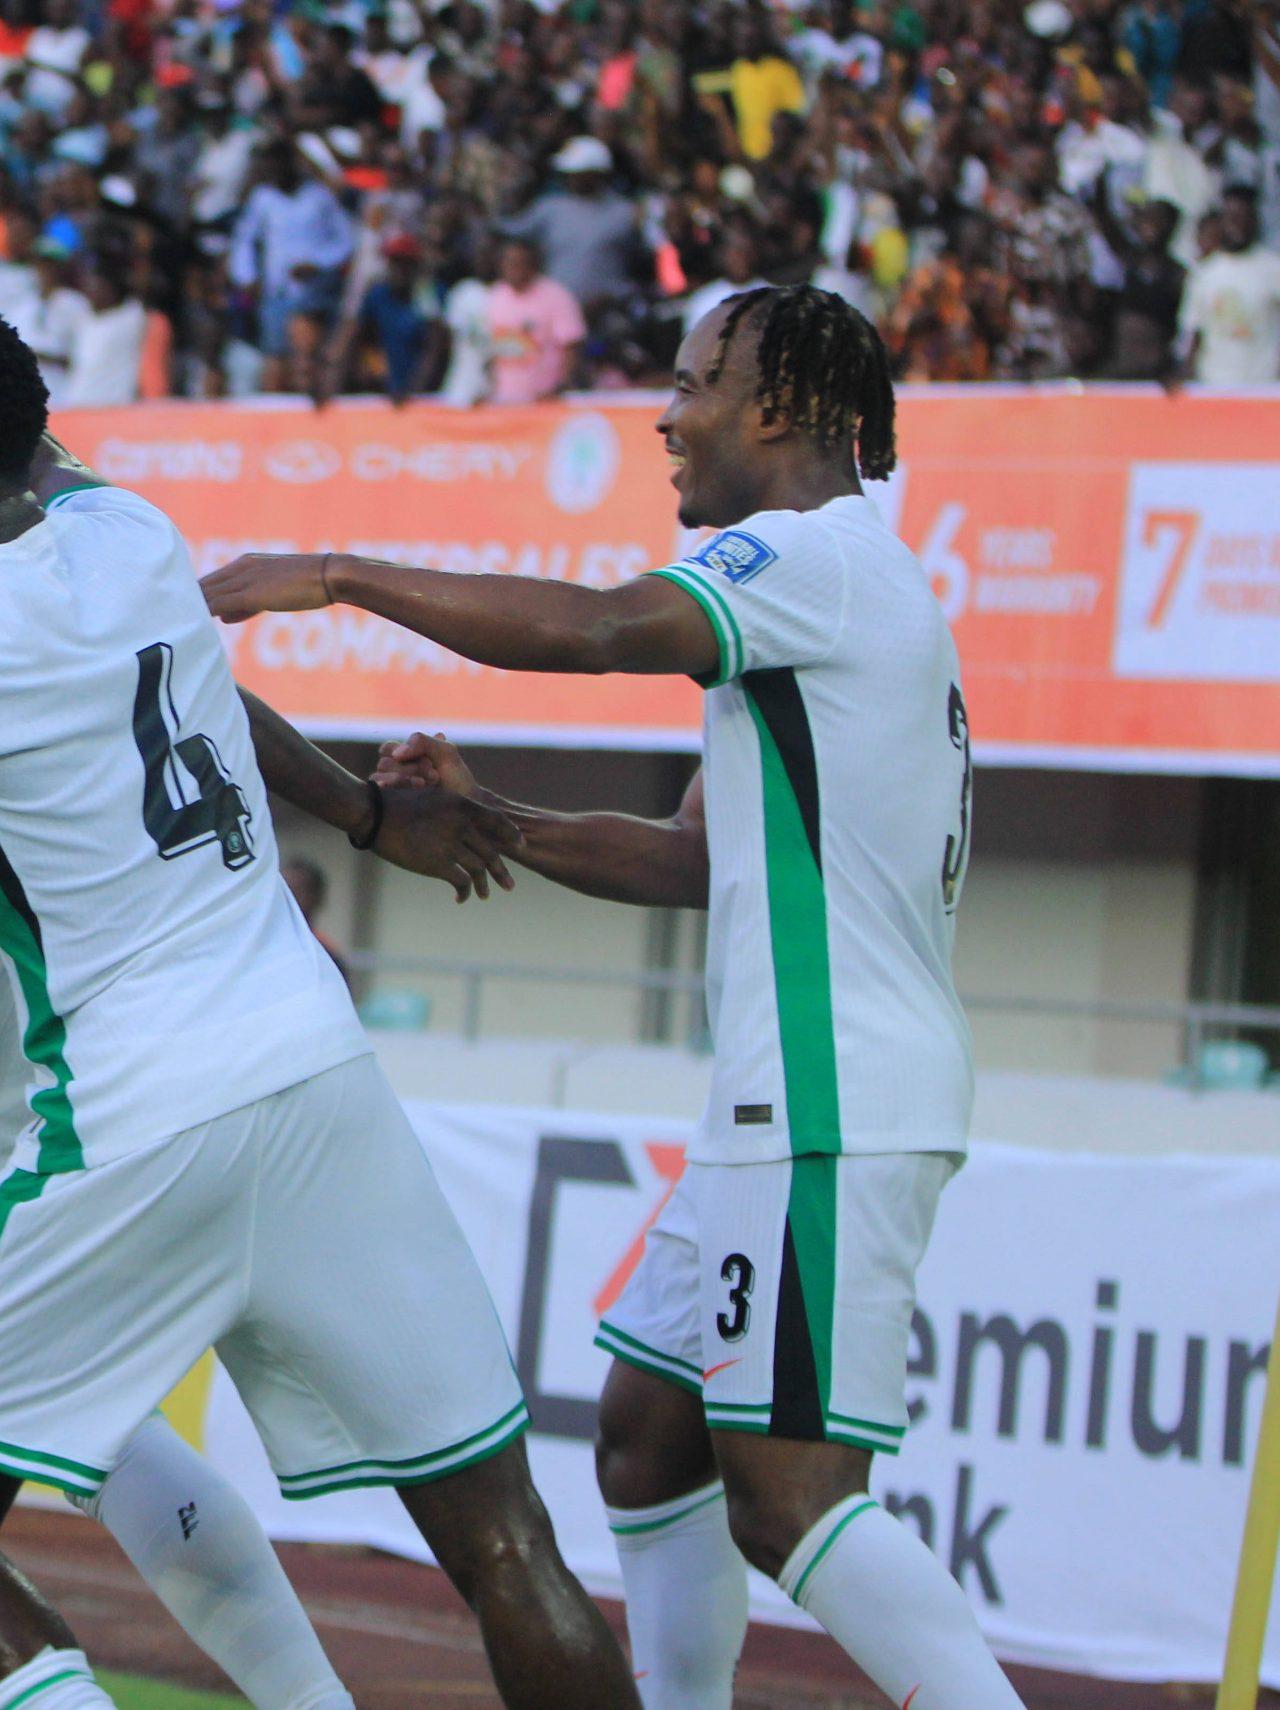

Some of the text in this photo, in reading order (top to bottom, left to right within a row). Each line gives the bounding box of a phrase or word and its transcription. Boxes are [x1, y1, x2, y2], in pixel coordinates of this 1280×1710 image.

[920, 500, 967, 624] 6
[1144, 511, 1201, 630] 7
[132, 641, 256, 872] 4
[717, 1253, 755, 1343] 3
